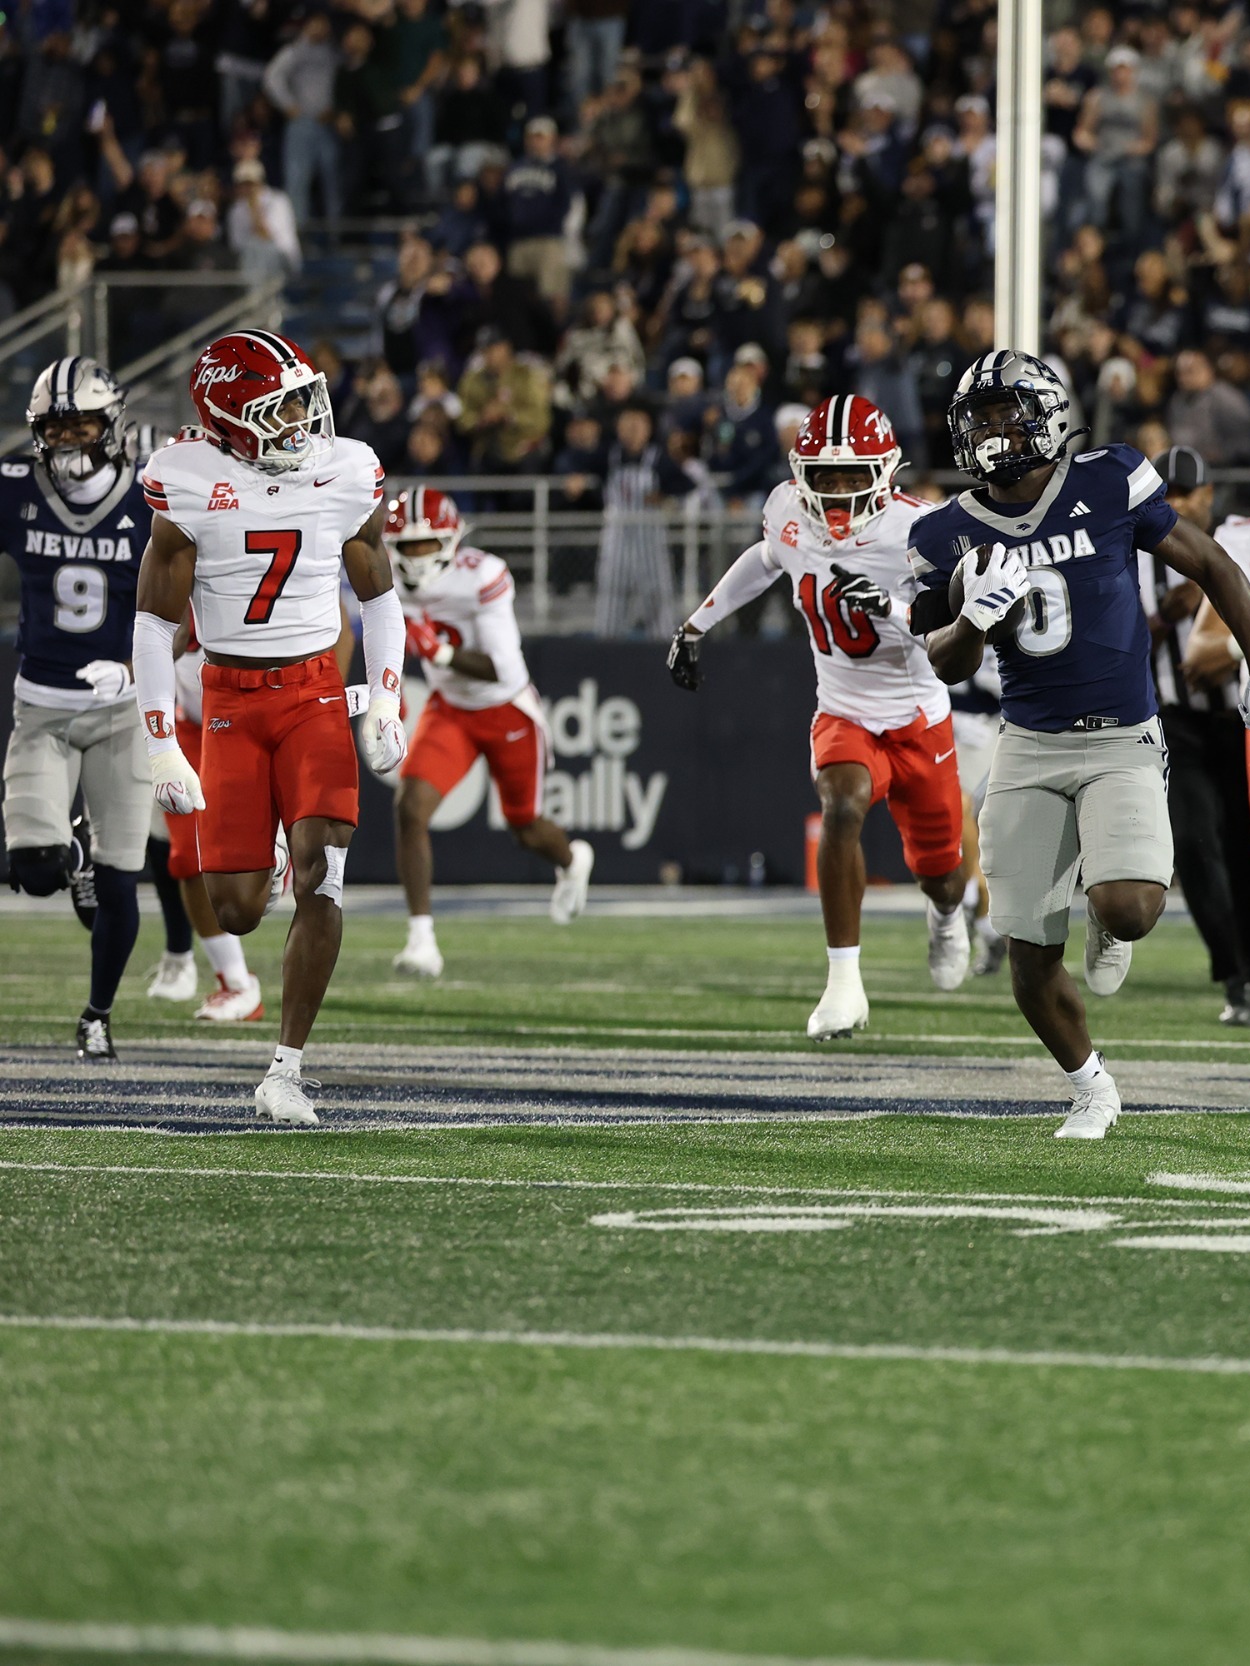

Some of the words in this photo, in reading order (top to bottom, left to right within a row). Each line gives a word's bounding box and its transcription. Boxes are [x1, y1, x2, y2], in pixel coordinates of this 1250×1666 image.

[194, 354, 243, 396] Tops
[976, 378, 994, 389] 775
[207, 498, 239, 511] USA
[25, 529, 133, 562] NEVADA
[244, 529, 302, 625] 7
[53, 564, 108, 634] 9
[798, 572, 881, 659] 10
[1014, 565, 1072, 657] 0
[207, 717, 232, 733] Tops
